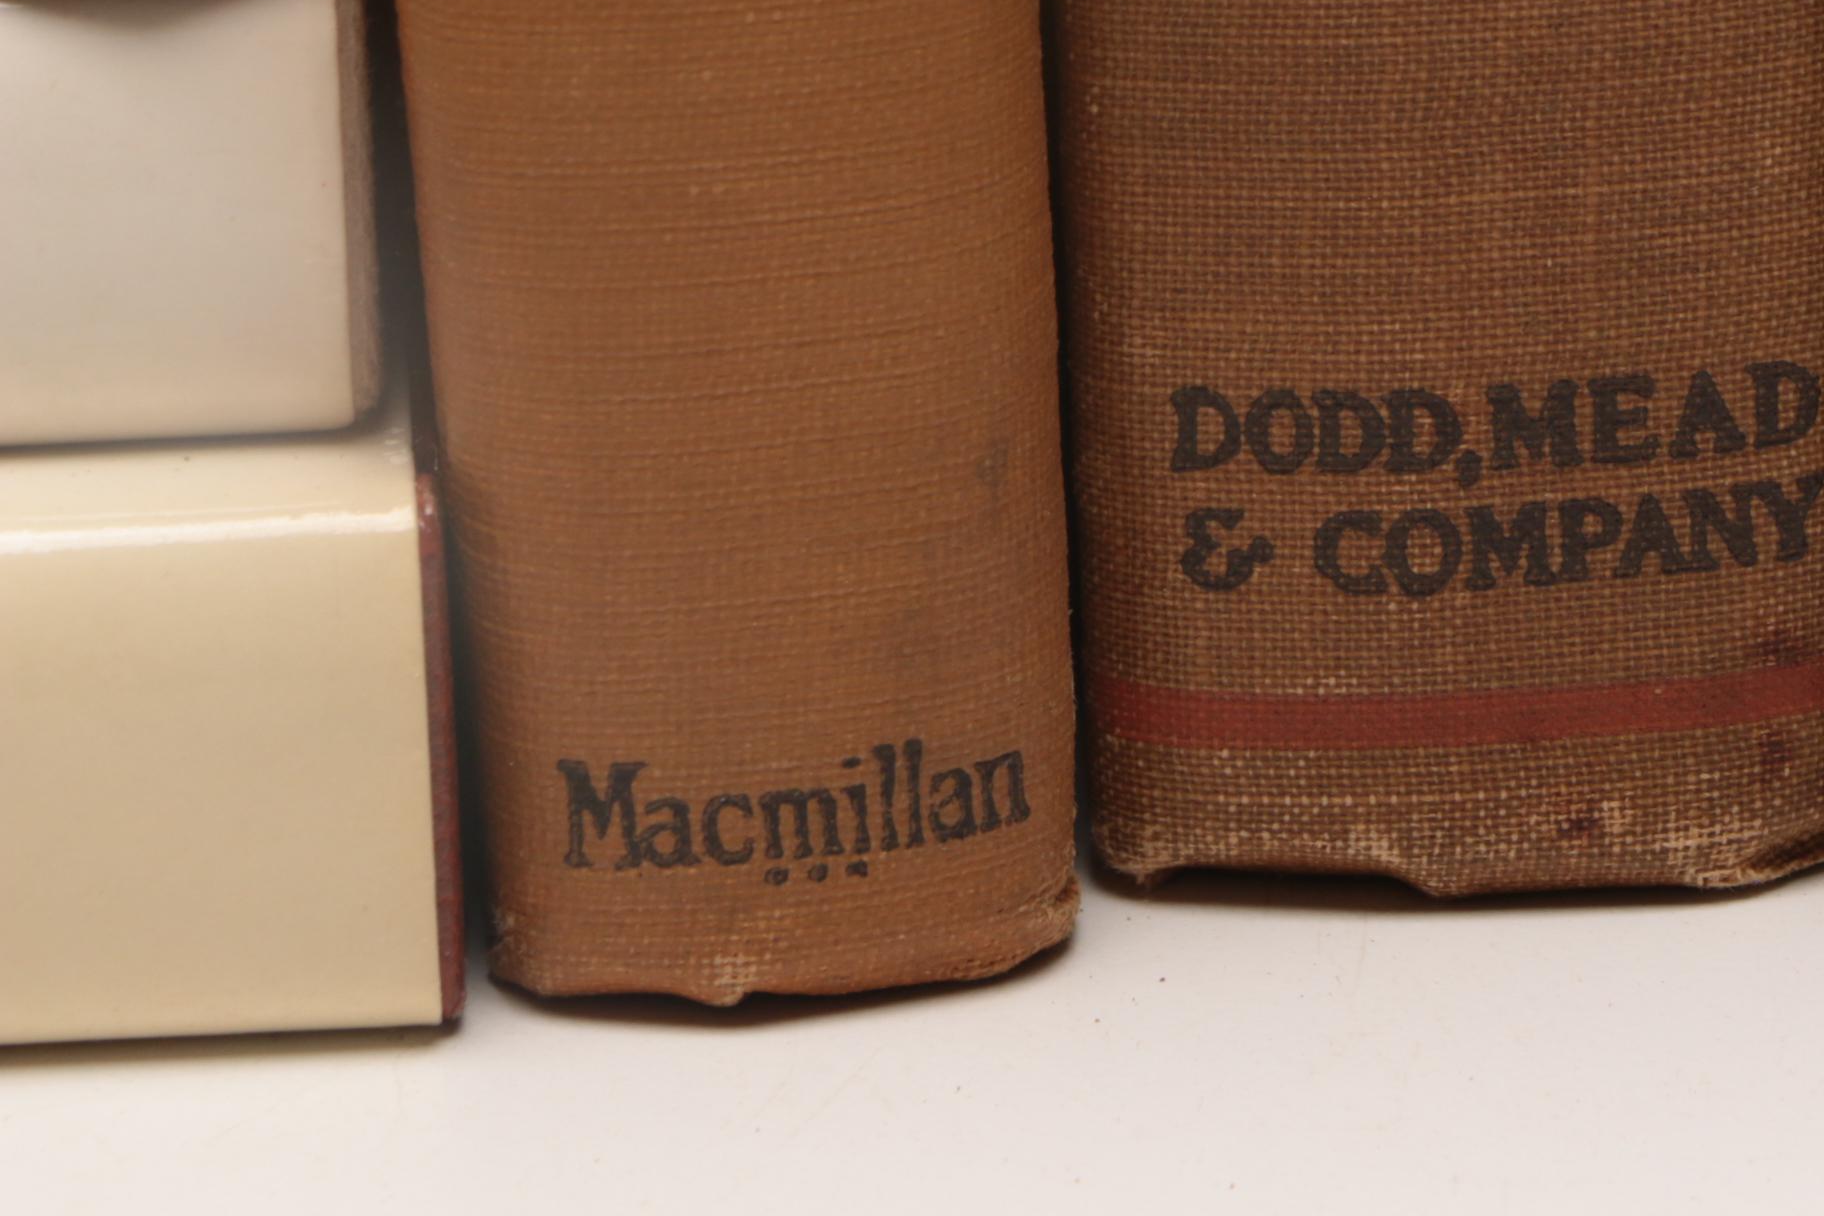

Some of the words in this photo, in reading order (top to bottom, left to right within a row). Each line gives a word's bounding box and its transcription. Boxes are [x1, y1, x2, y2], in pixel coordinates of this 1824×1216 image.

[1169, 384, 1482, 488] DODD,
[1485, 360, 1822, 471] MEAD
[1179, 508, 1275, 591] &
[555, 737, 1032, 872] Macmillan
